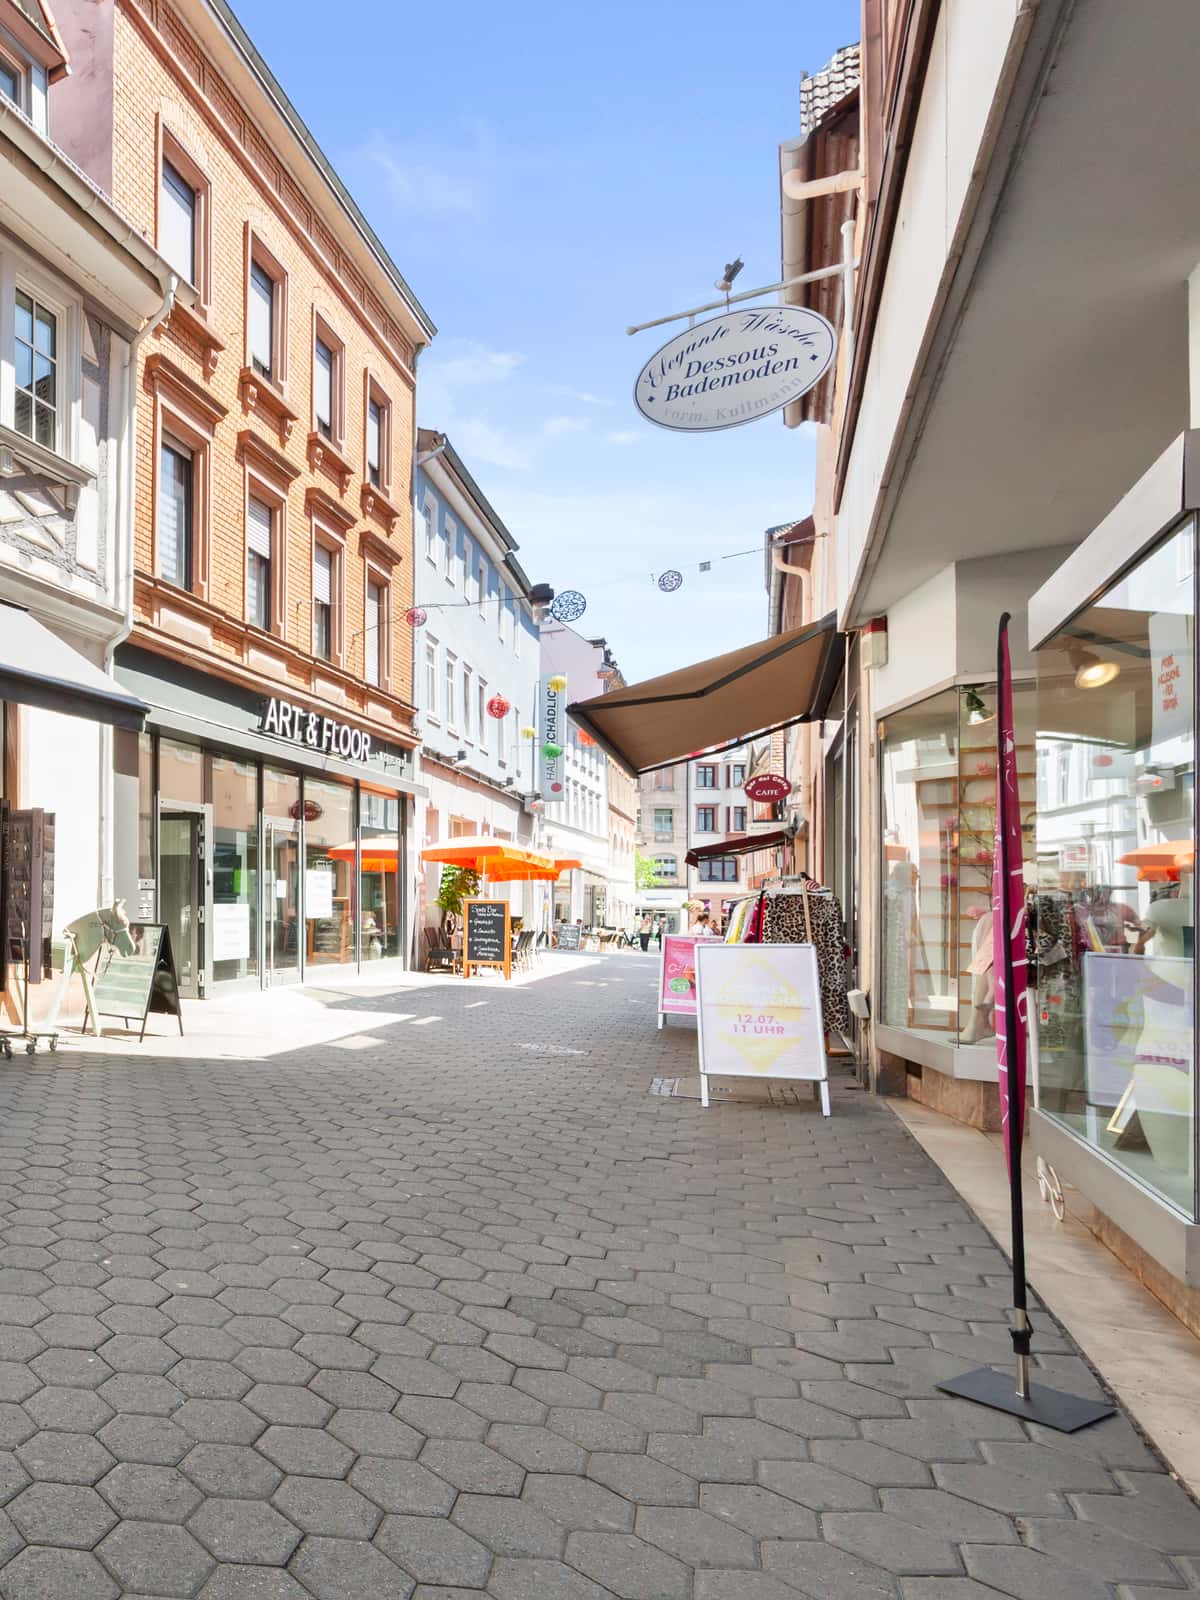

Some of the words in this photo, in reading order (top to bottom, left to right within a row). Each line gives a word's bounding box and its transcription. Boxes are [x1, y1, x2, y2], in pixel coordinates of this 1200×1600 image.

[644, 325, 730, 388] Elegante
[740, 313, 820, 347] Wäsche
[684, 343, 778, 379] Dessous
[665, 355, 799, 402] Bademoden
[265, 697, 304, 740] ART
[307, 711, 319, 747] &
[322, 717, 371, 761] FLOOR
[545, 682, 557, 744] CHÄDLIC
[731, 1023, 747, 1033] 11
[753, 1024, 785, 1035] UHR
[736, 1013, 779, 1024] 12.07.
